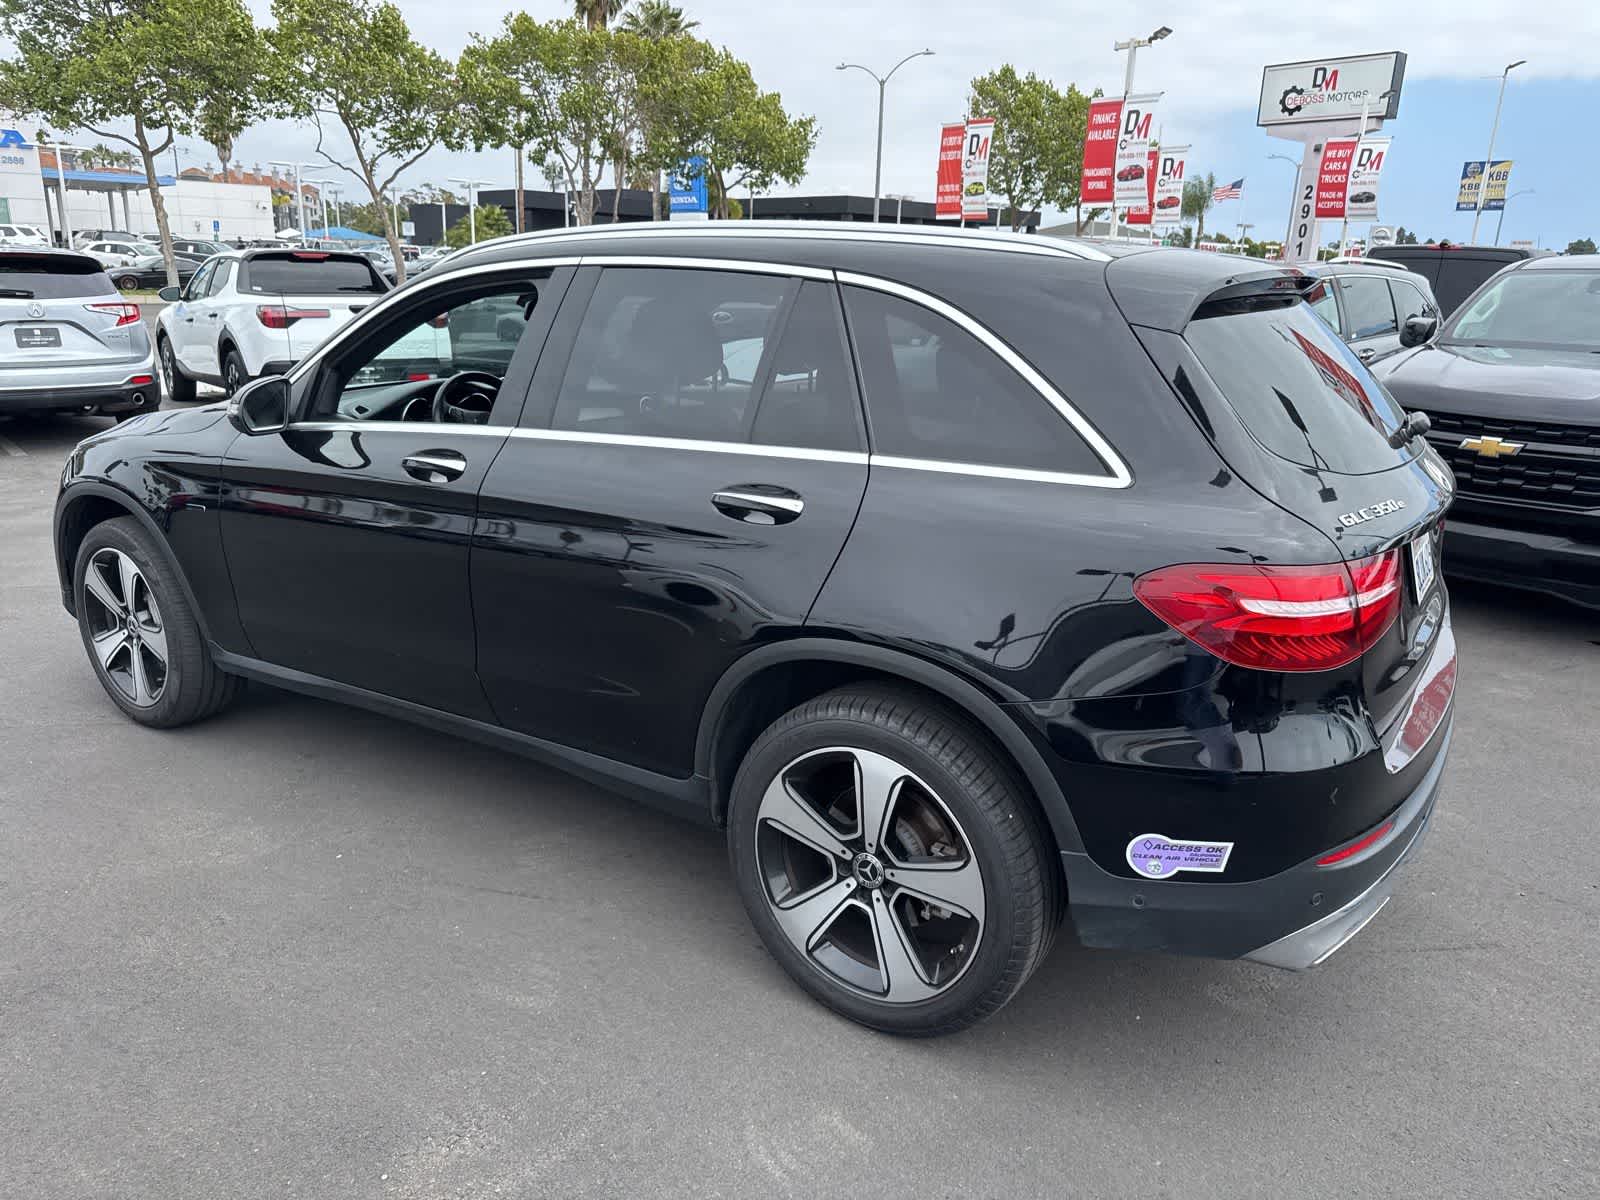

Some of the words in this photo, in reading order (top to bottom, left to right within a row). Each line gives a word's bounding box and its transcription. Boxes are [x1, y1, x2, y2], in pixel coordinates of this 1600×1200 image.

[1287, 93, 1325, 106] DEBOSS
[1327, 90, 1369, 102] MOTORS
[1092, 112, 1116, 125] FINANCE
[1087, 128, 1117, 141] AVAILABLE
[1326, 149, 1337, 158] WE
[1337, 148, 1353, 157] BUY
[1324, 161, 1342, 171] CARS
[1320, 174, 1347, 184] TRUCKS
[1488, 170, 1510, 181] KBB
[1317, 201, 1344, 209] ACCEPTED
[1295, 184, 1314, 257] 2901
[1153, 843, 1202, 853] ACCESS
[1206, 846, 1225, 854] OK
[1133, 852, 1162, 860] CLEAN
